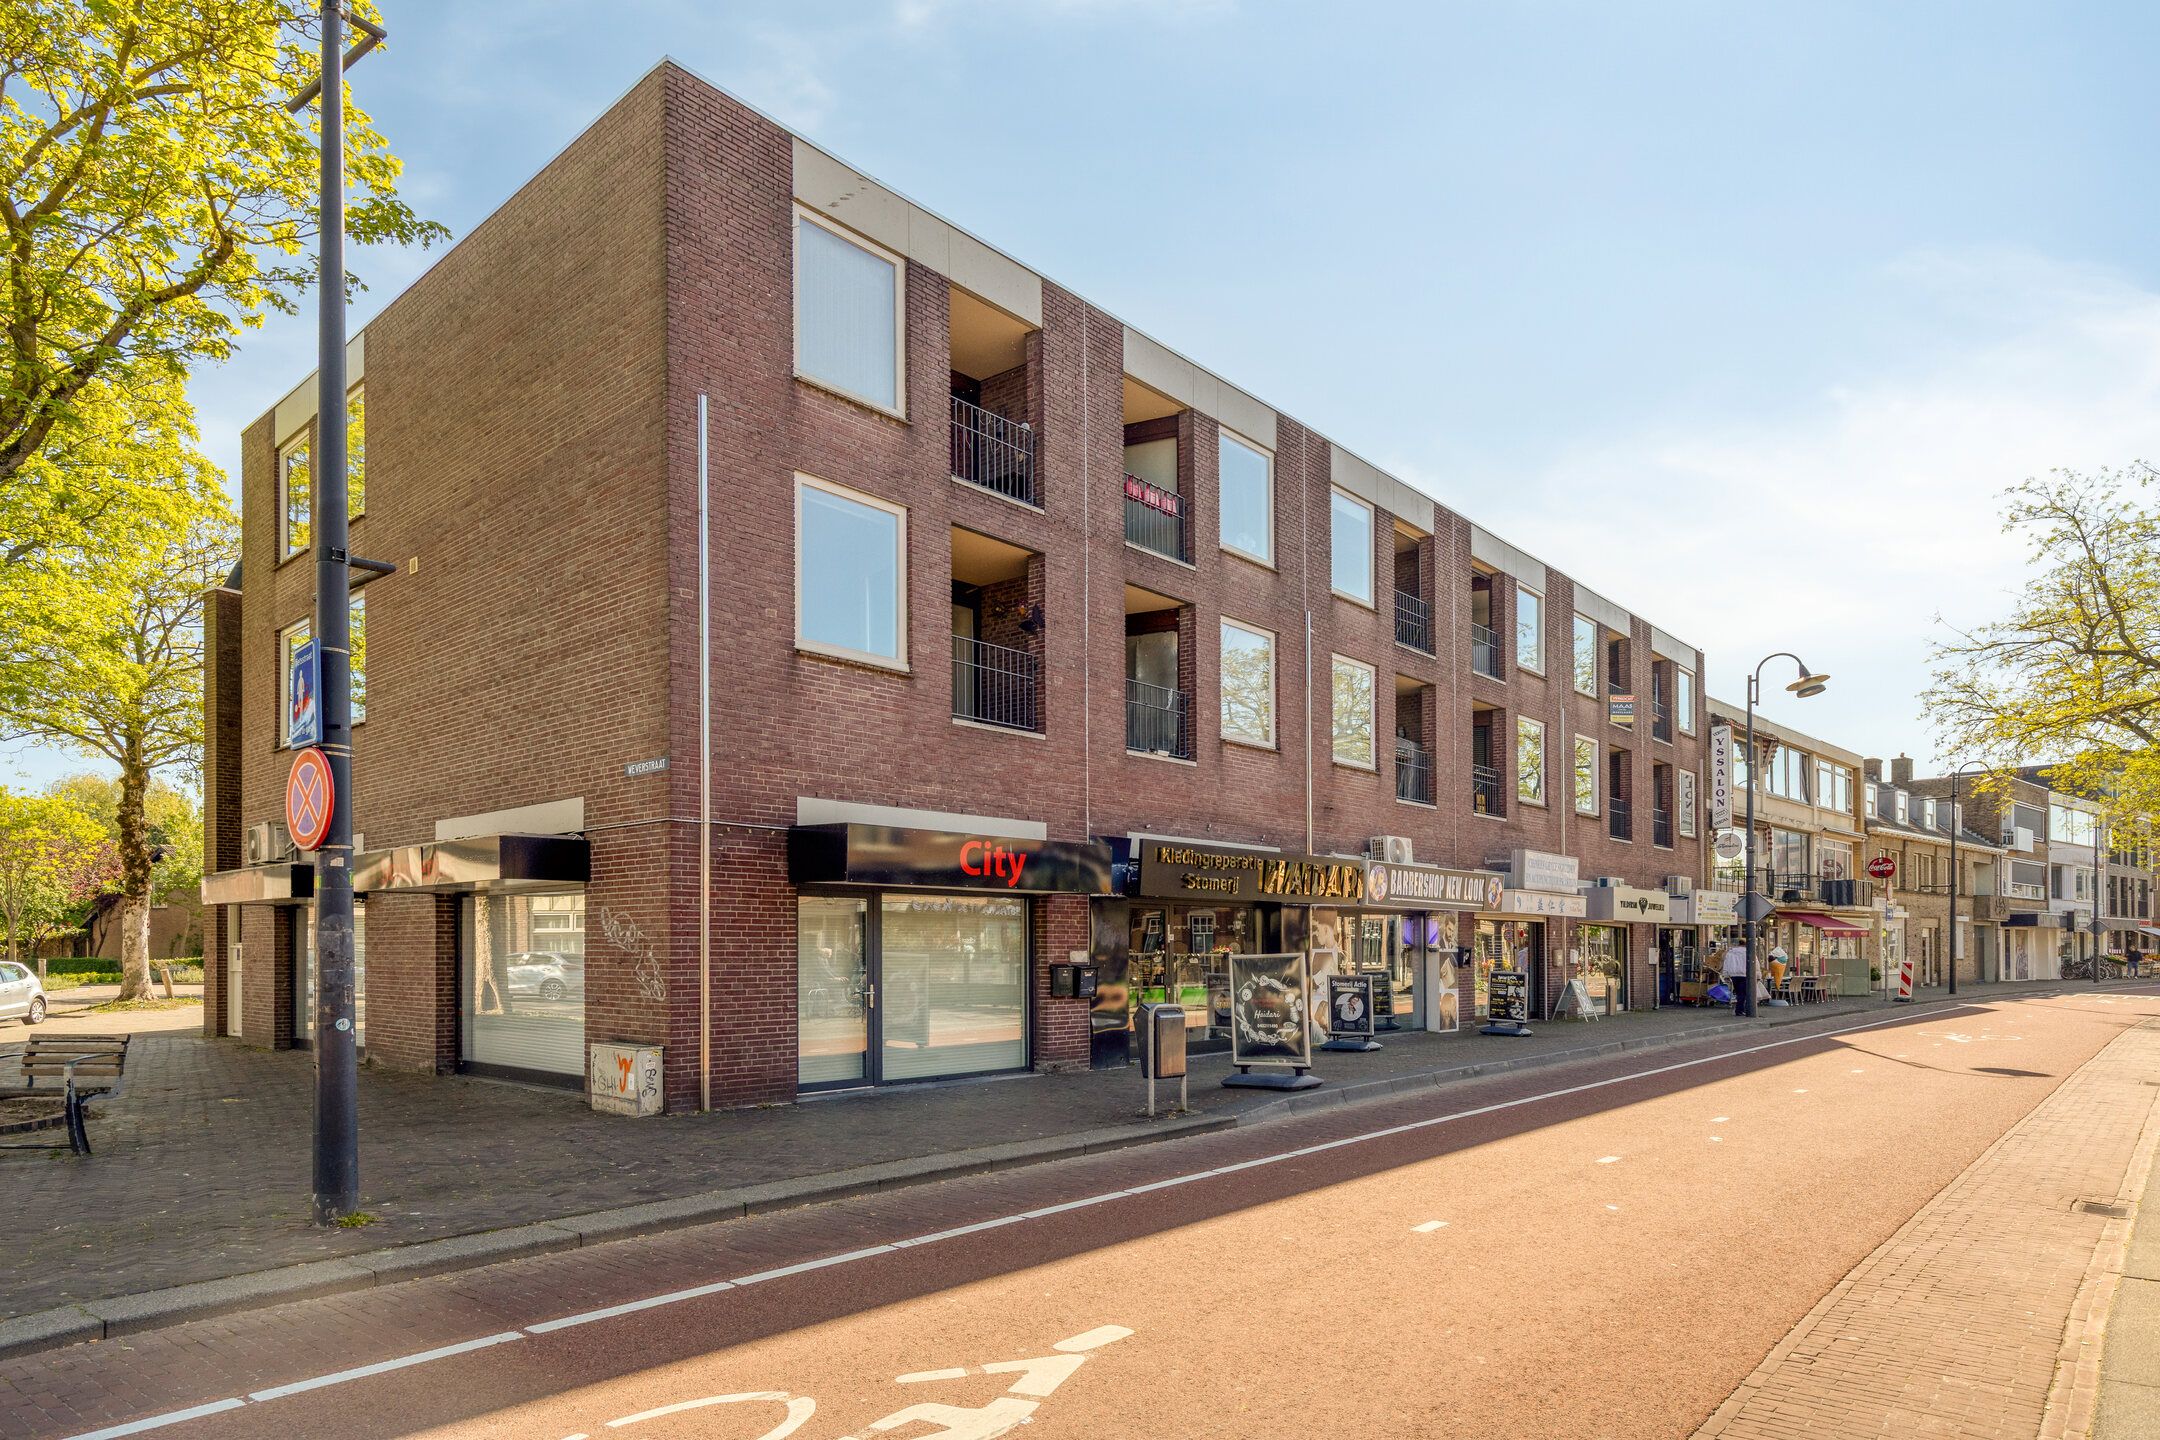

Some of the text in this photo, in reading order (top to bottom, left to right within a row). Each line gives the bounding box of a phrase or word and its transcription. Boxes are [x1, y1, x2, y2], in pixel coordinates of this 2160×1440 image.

[1715, 738, 1726, 807] YSSALON
[959, 840, 1027, 887] City
[1159, 847, 1264, 870] Kledingreparatie
[1185, 873, 1240, 894] Stomerij
[1390, 869, 1485, 902] BARBERSHOP NEW LOOK
